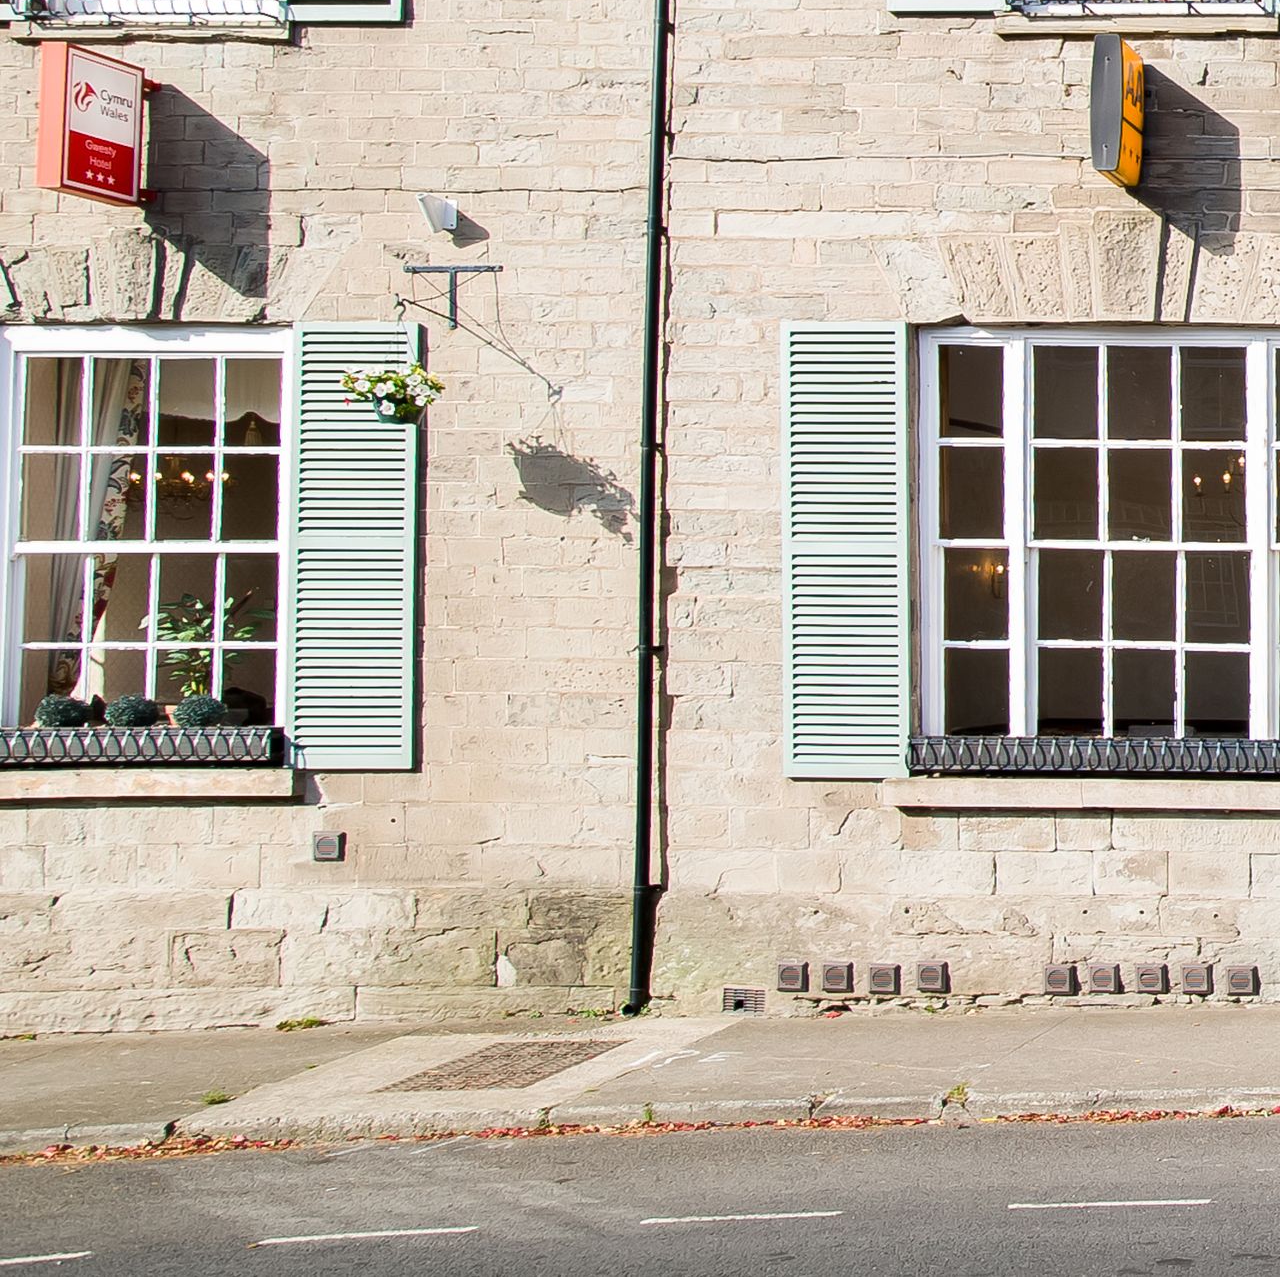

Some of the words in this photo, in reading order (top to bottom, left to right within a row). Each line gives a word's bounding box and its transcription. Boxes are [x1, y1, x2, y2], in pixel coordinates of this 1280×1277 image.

[1125, 61, 1143, 114] AA
[100, 89, 133, 109] Cymru
[100, 105, 129, 123] Wales
[85, 139, 117, 159] Gwesty
[89, 156, 112, 170] Hotel
